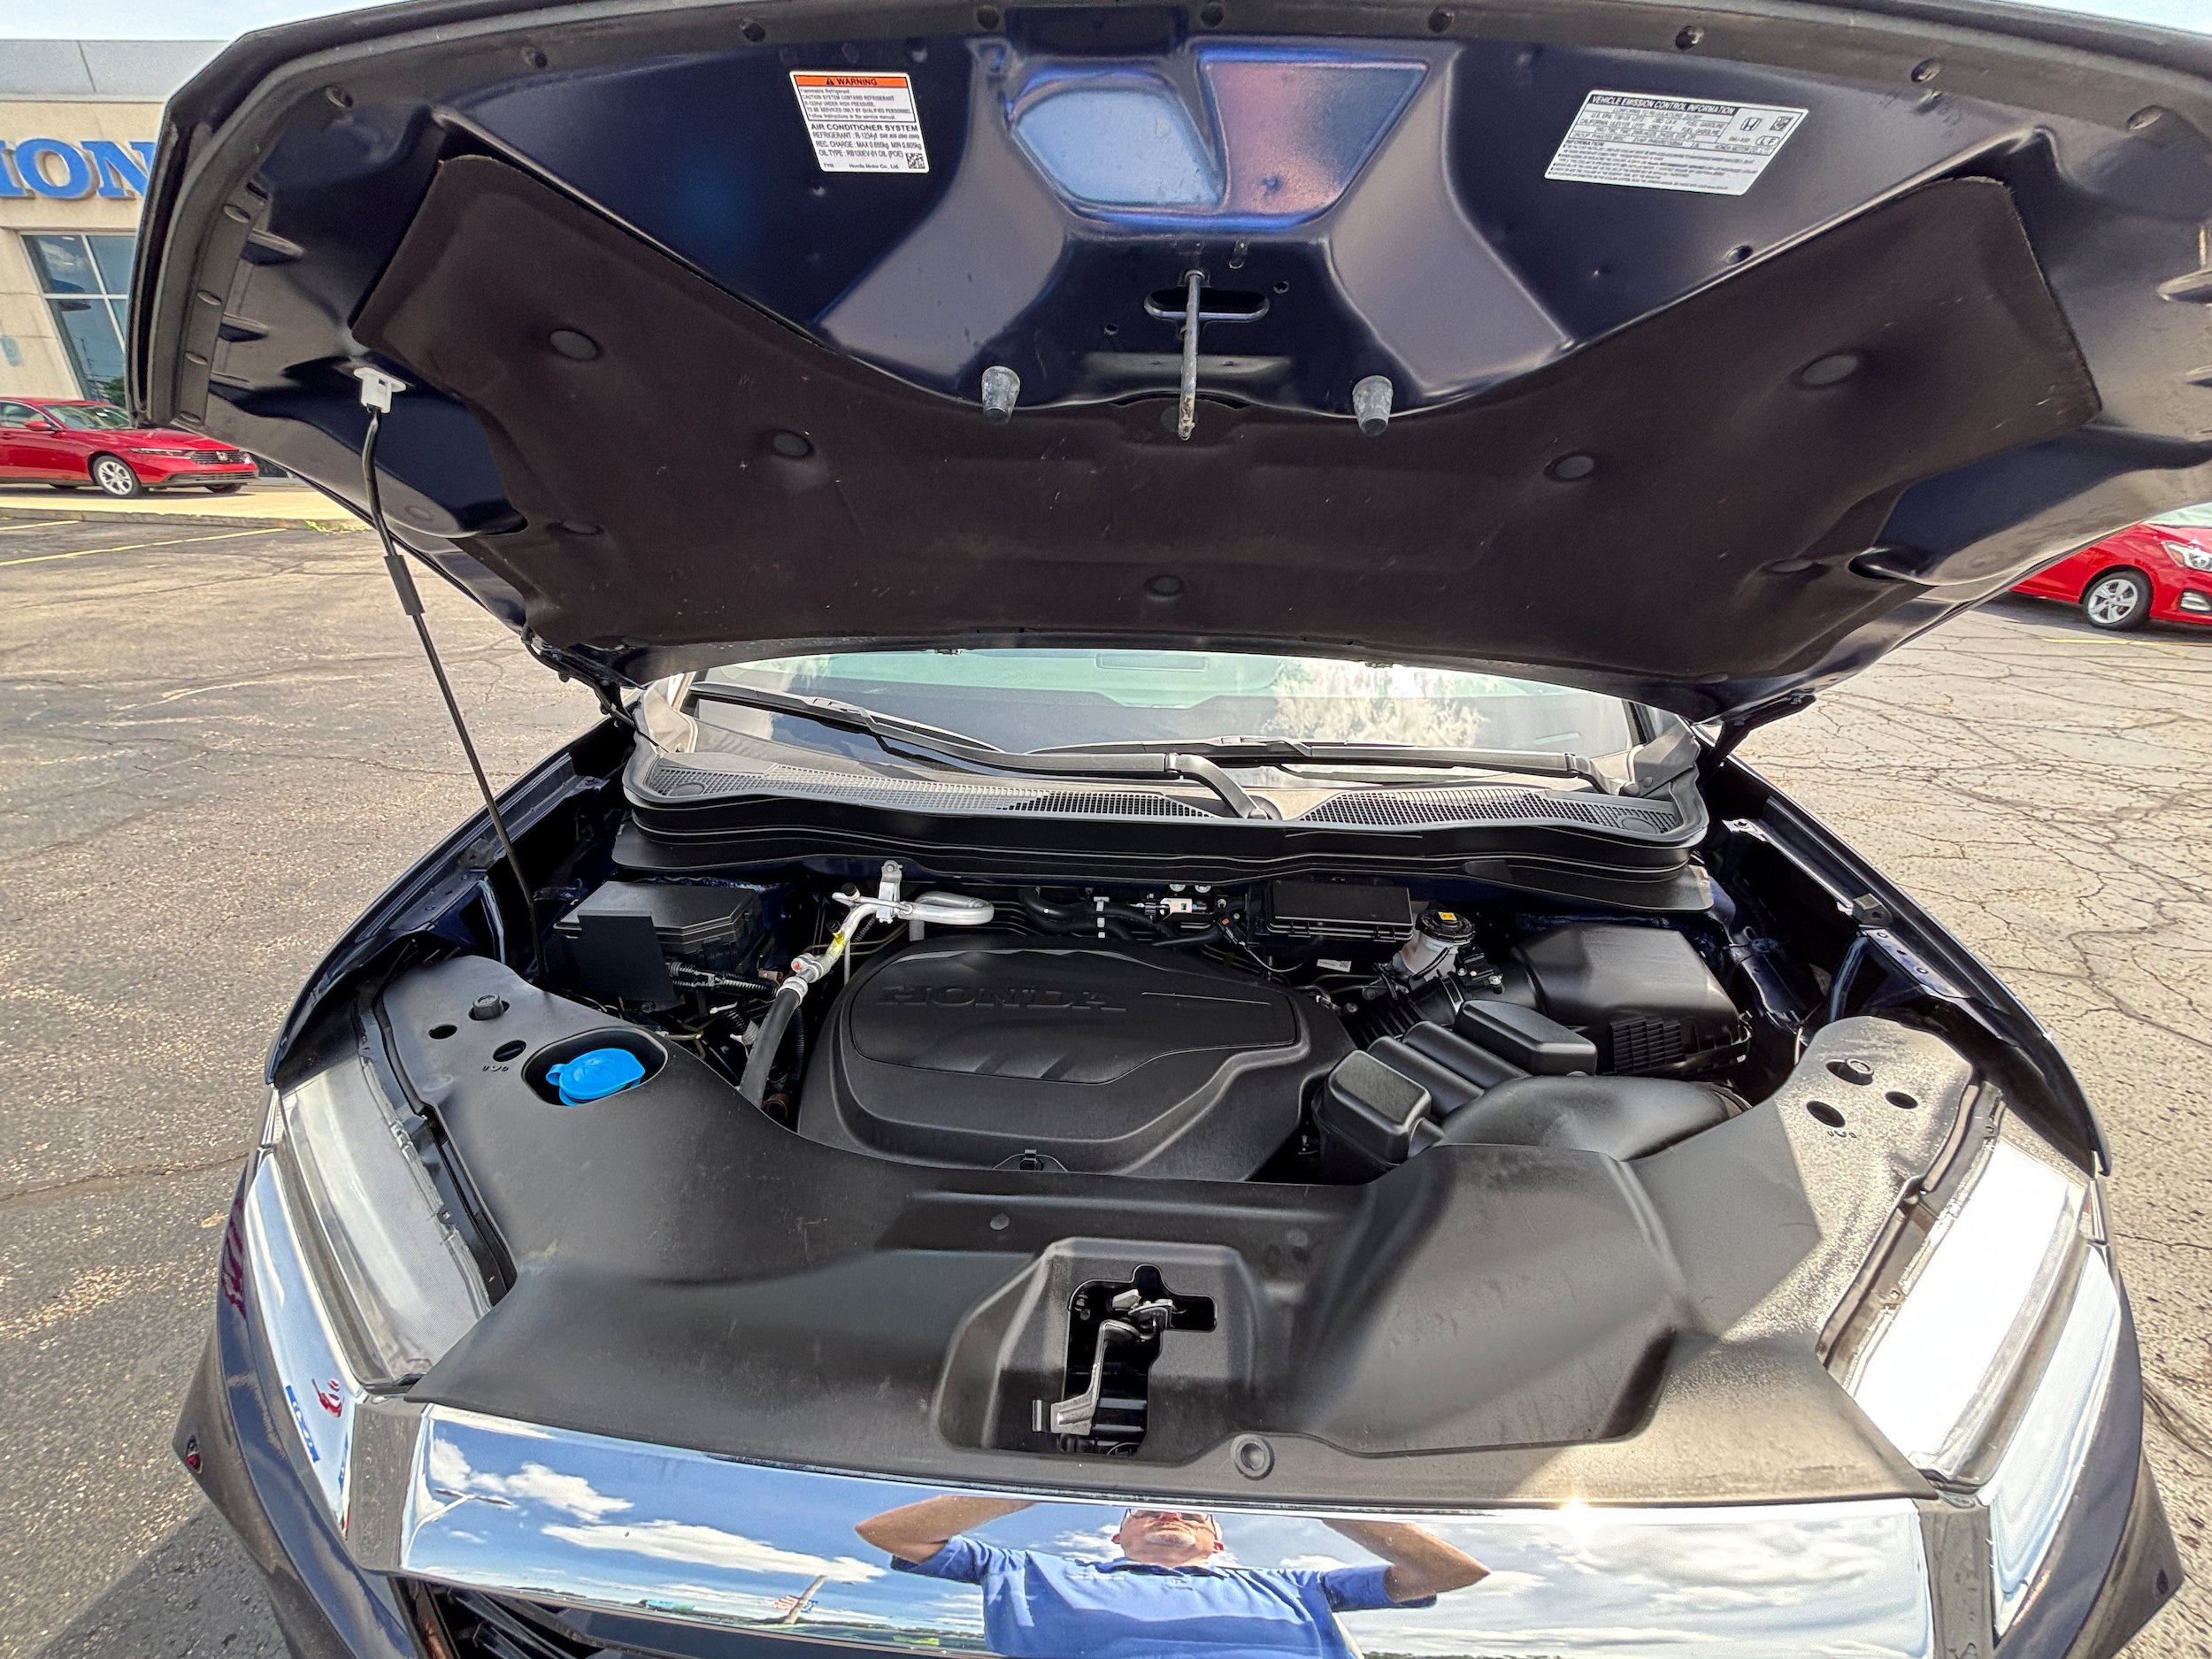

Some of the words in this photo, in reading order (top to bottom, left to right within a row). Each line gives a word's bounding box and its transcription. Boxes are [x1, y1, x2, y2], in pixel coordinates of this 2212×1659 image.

[1589, 95, 1622, 104] VEHICLE
[1619, 97, 1655, 108] EMISSION
[1652, 100, 1689, 111] CONTROL
[1686, 103, 1736, 114] INFORMATION
[887, 150, 904, 159] (POE)
[875, 986, 1126, 1011] HONDA
